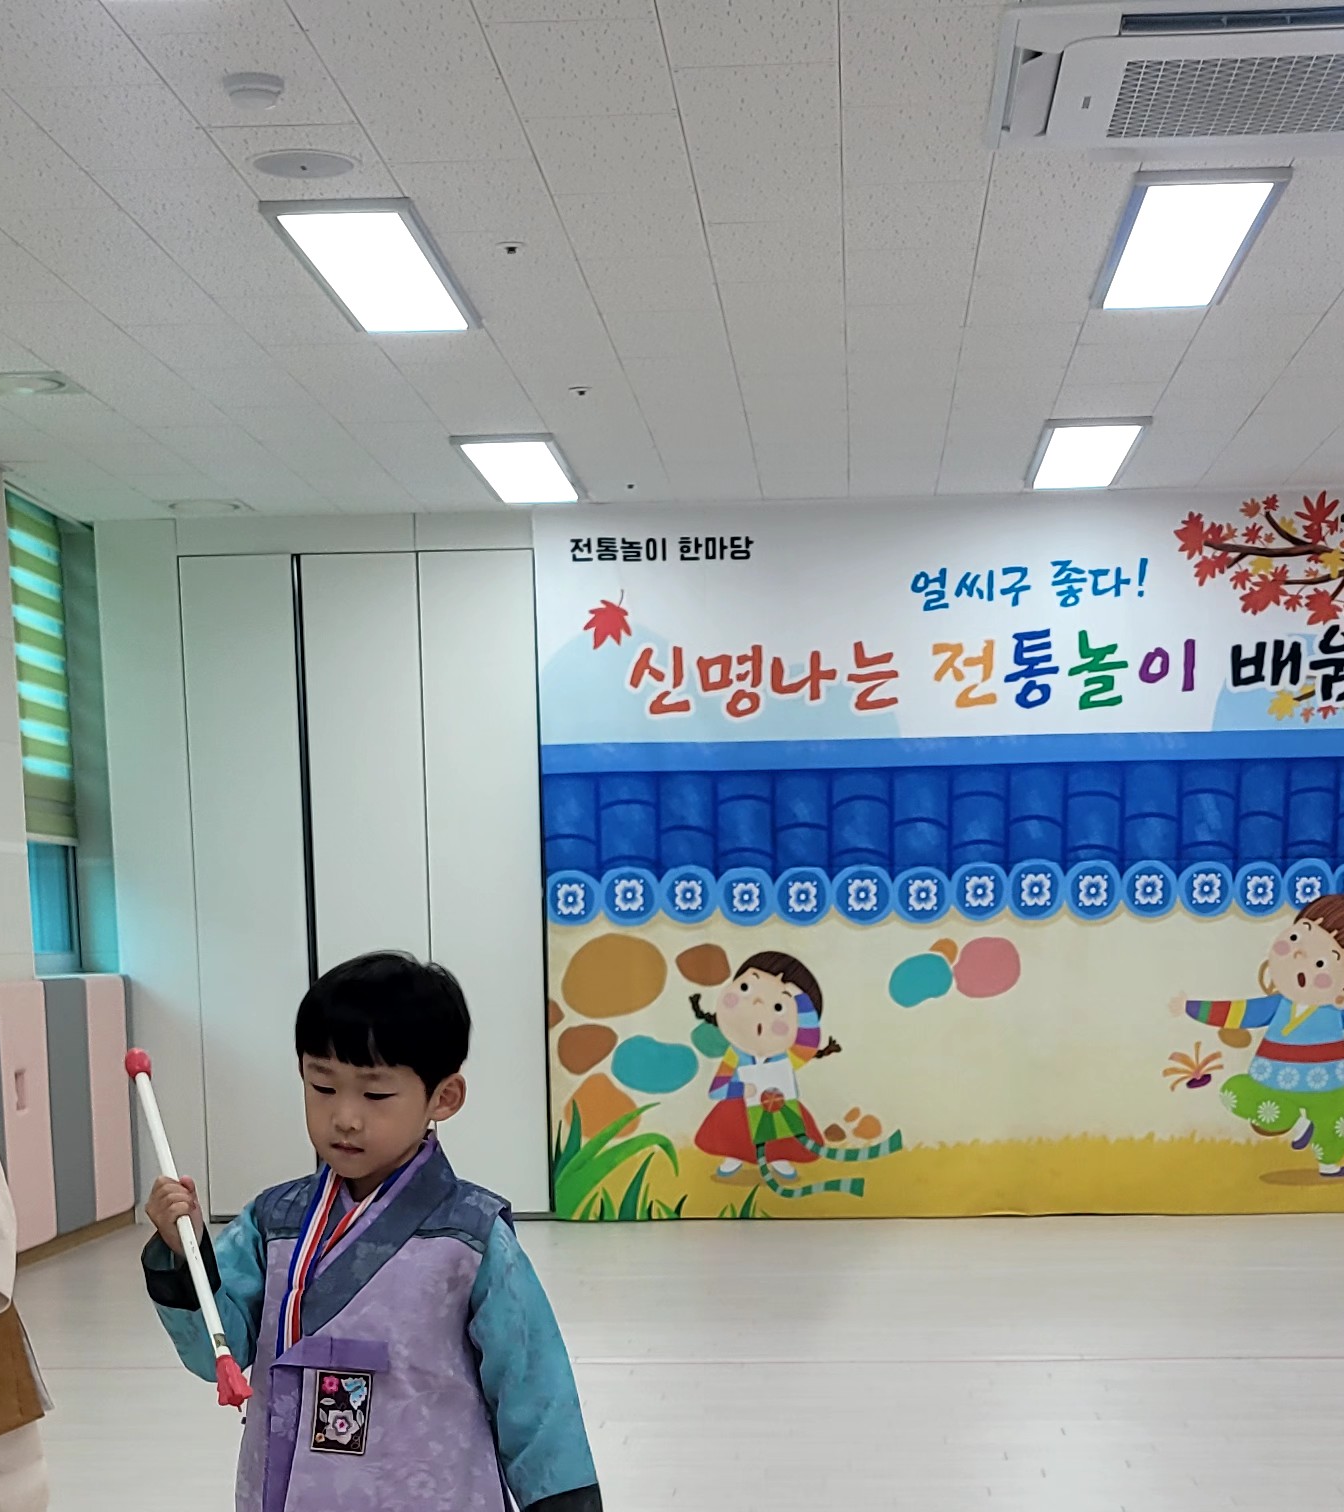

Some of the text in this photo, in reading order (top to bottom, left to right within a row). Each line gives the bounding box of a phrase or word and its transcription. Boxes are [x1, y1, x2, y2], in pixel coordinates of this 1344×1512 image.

[569, 536, 755, 563] 전통놀이 한마당
[910, 557, 1149, 612] 얼씨구 좋다!
[629, 640, 900, 719] 신명나는
[931, 628, 1197, 710] 전통놀이
